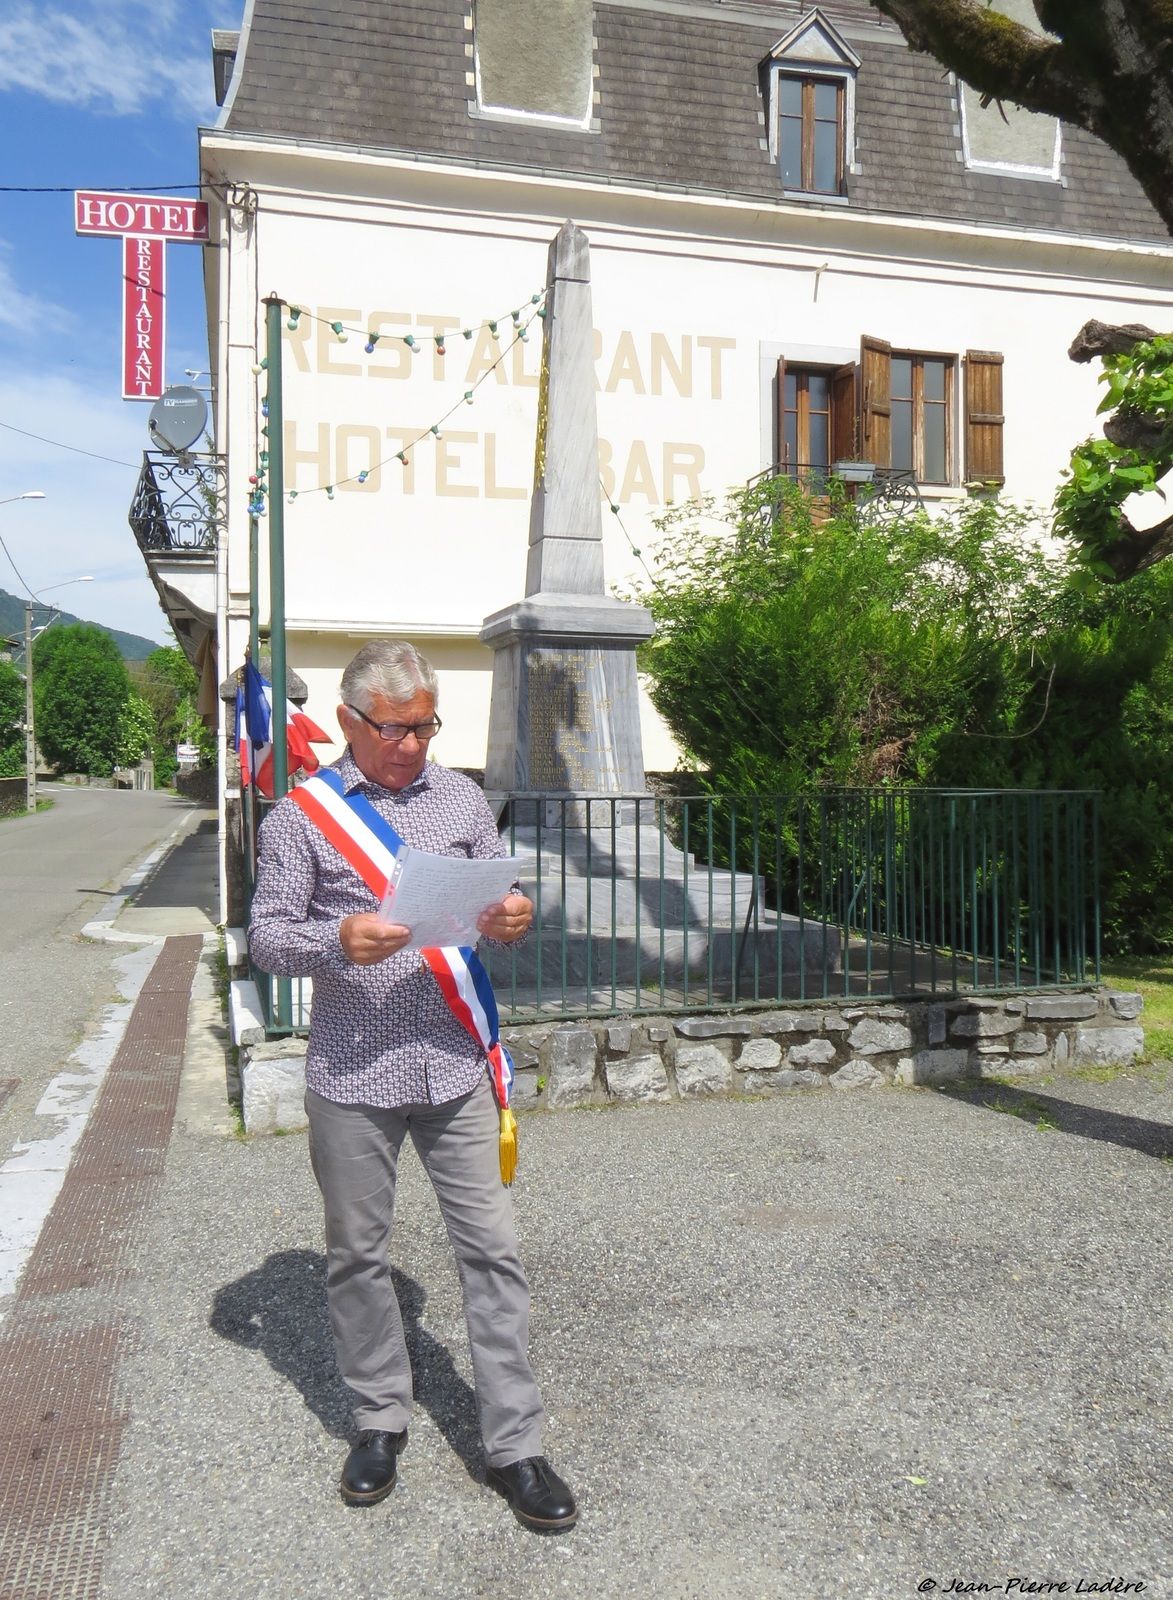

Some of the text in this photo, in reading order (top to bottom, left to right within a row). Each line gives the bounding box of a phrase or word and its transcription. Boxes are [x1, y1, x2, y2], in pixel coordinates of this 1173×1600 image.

[80, 199, 206, 234] HOTEL
[135, 239, 153, 396] RESTAURANT
[284, 420, 528, 500] HOTEL
